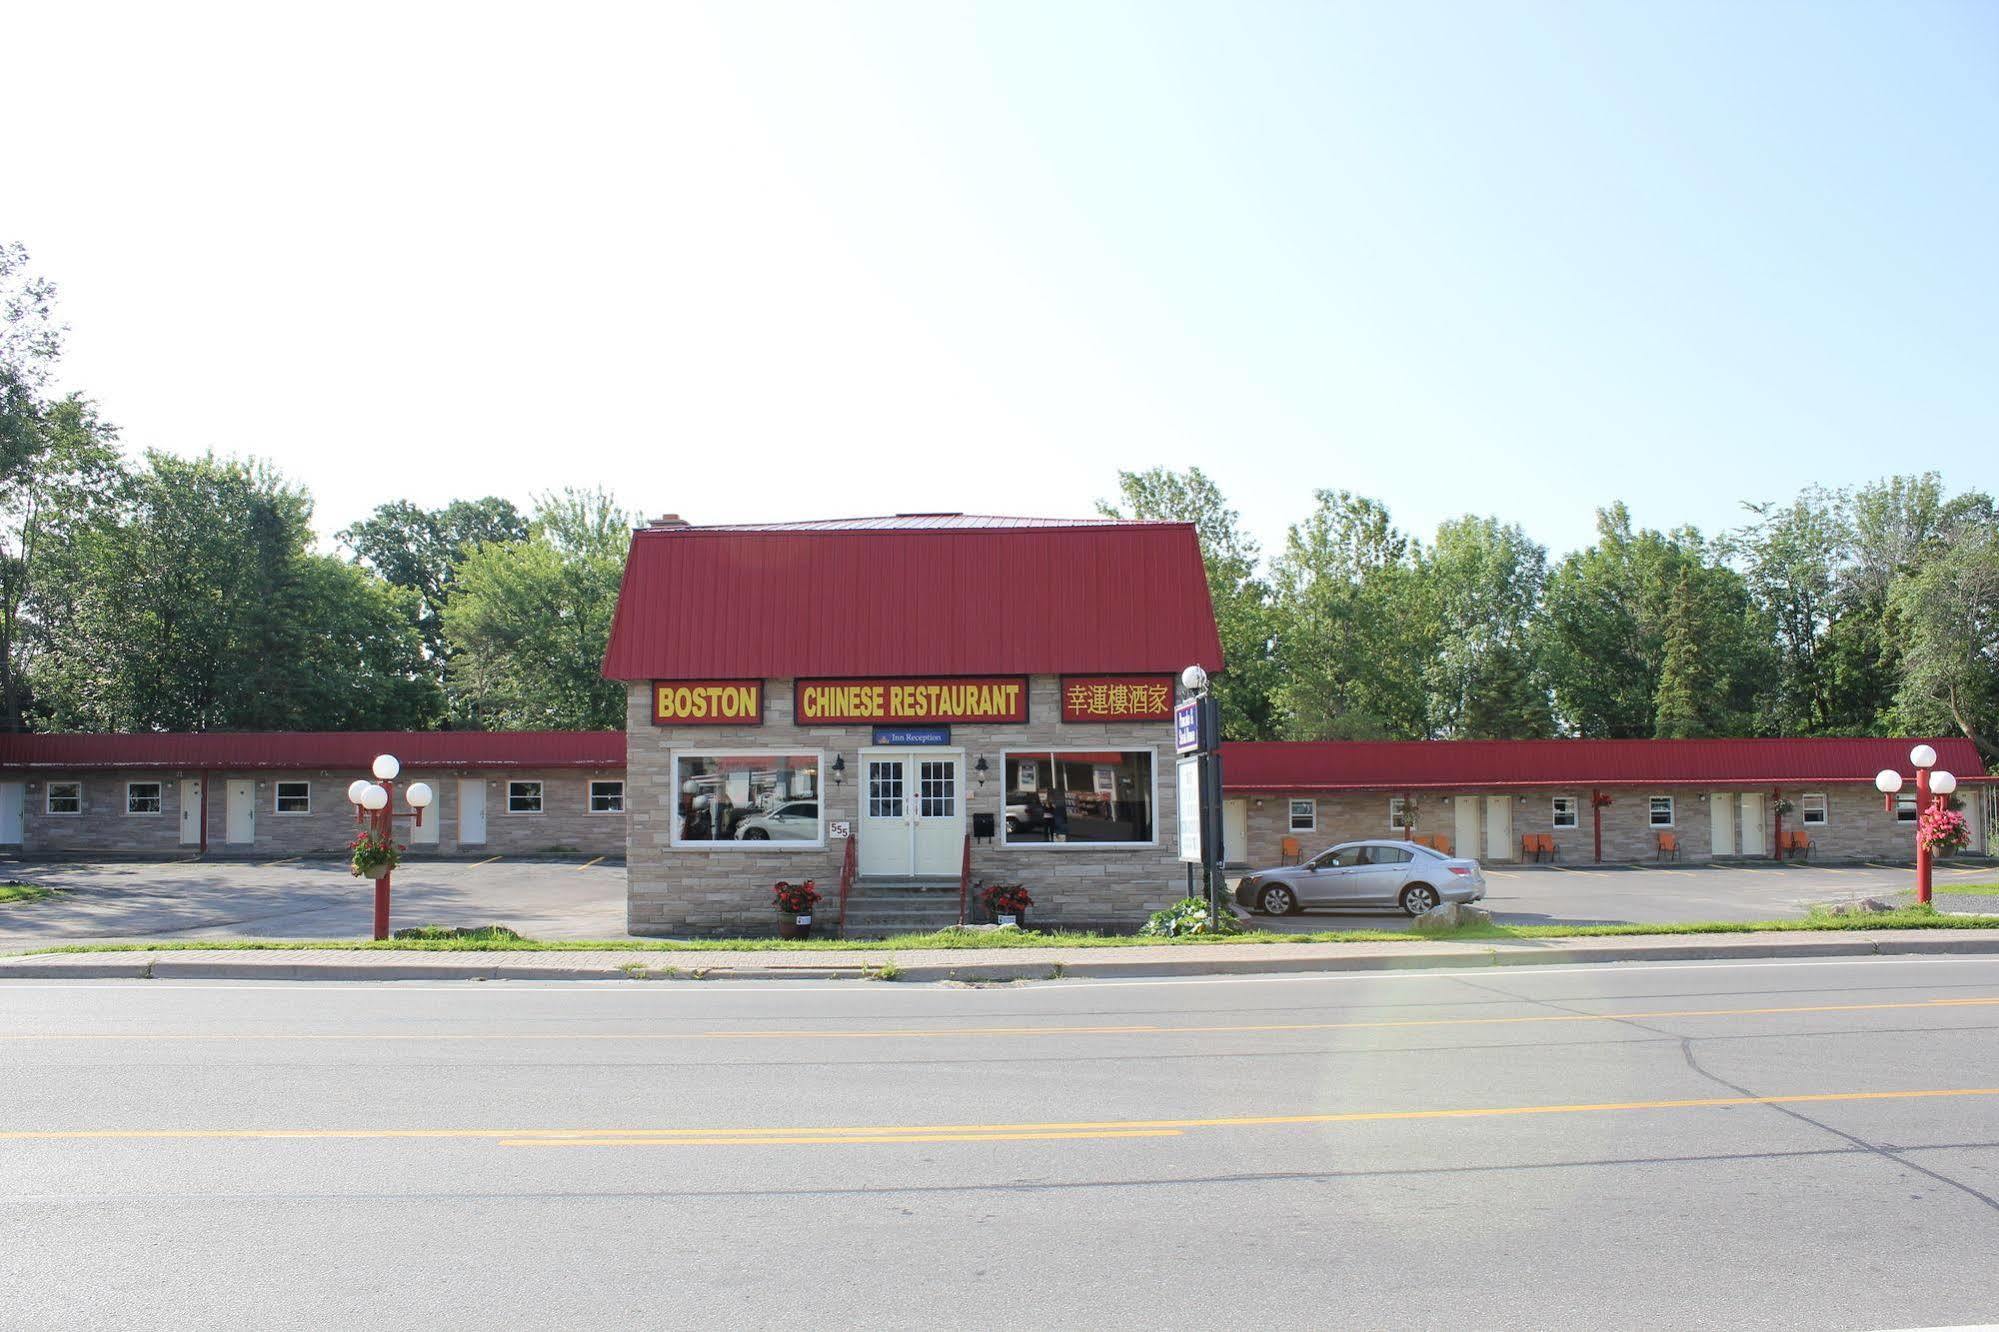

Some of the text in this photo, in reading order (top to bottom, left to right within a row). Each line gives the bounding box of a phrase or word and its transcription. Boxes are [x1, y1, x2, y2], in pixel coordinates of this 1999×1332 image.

[658, 686, 757, 718] BOSTON
[803, 685, 1019, 717] CHINESE RESTAURANT
[1067, 684, 1169, 715] 幸運樓酒家
[892, 733, 942, 743] Inn Reception
[831, 822, 848, 837] 555
